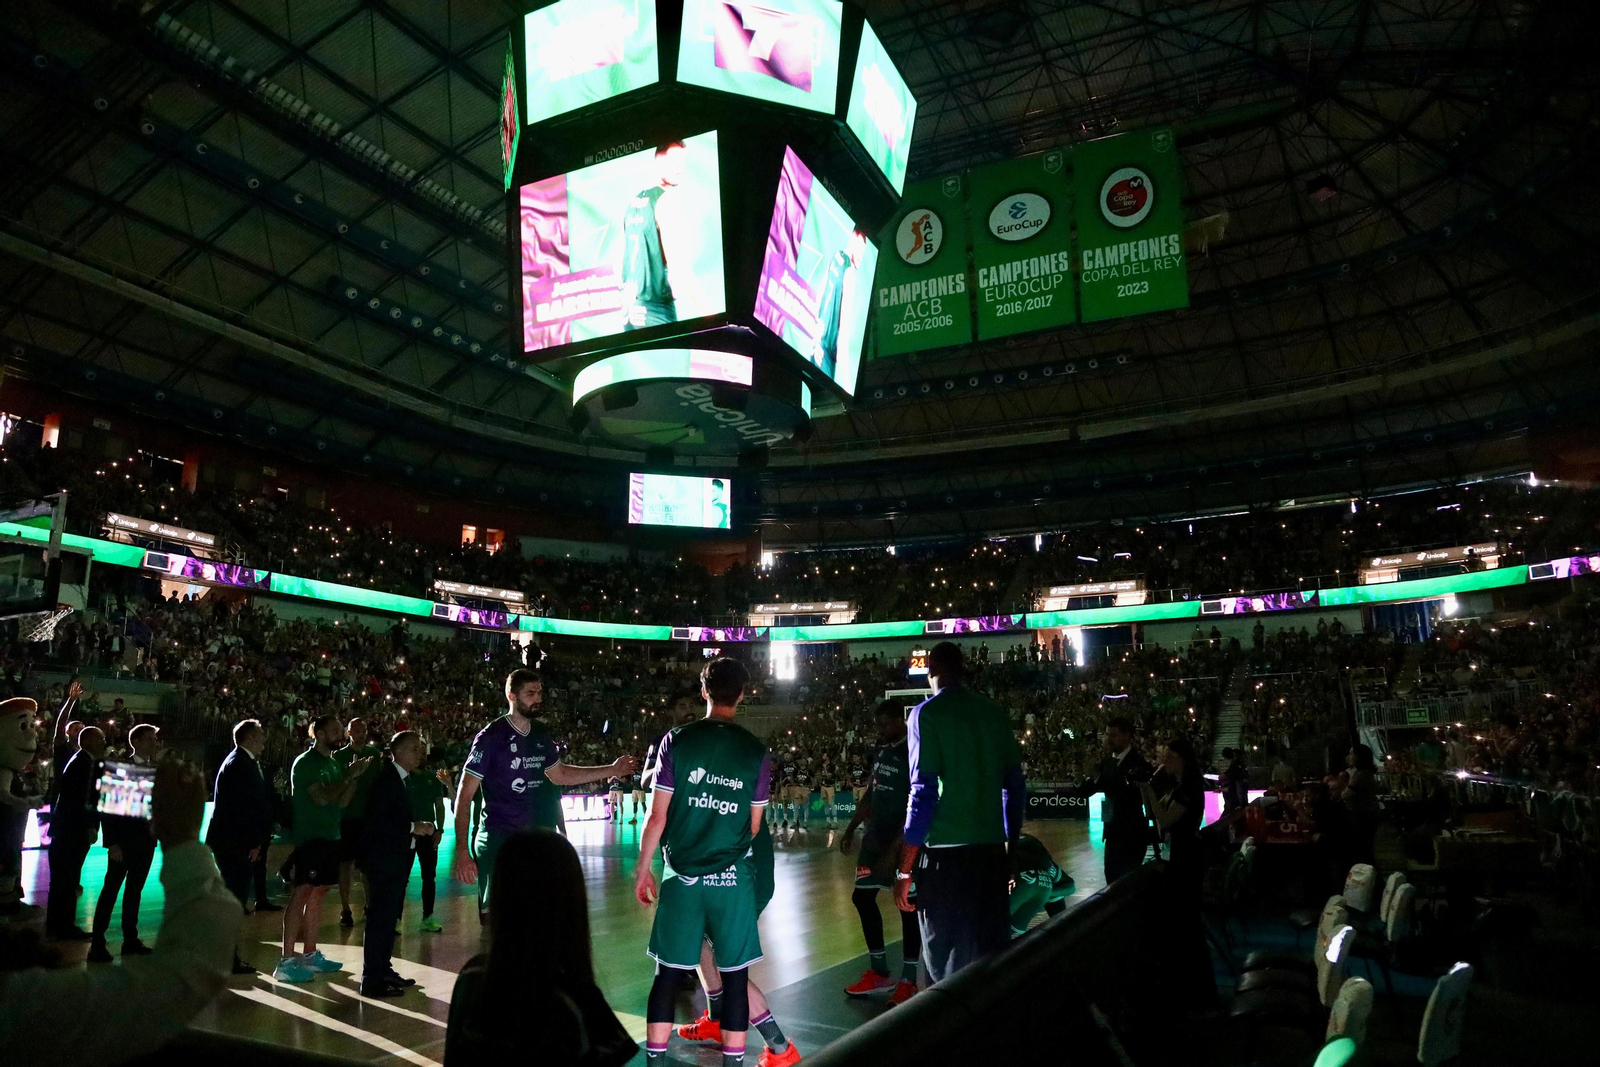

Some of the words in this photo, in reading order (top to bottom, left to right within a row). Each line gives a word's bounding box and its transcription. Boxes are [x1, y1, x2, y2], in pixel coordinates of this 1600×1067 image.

[596, 139, 644, 164] MONDO
[1113, 194, 1134, 202] Copa
[997, 218, 1043, 235] EuroCup
[1082, 233, 1181, 270] CAMPEONES
[978, 251, 1069, 289] CAMPEONES
[1082, 268, 1119, 283] COPA
[1122, 262, 1150, 277] DEL
[1153, 255, 1182, 271] REY
[879, 273, 966, 308] CAMPEONES
[985, 274, 1064, 303] EUROCUP
[1117, 281, 1149, 297] 2023
[903, 298, 943, 321] ACB
[996, 294, 1053, 317] 2016/2017
[893, 314, 953, 336] 2005/2006
[676, 384, 784, 446] Unicaja
[118, 518, 139, 528] Unicaja
[159, 528, 178, 537] Unicaja
[195, 535, 214, 545] Unicaja
[911, 657, 926, 669] 24
[522, 762, 542, 770] Unicaja
[706, 774, 744, 790] Unicaja
[1029, 795, 1087, 807] endesa
[703, 877, 737, 887] MÁLAGA
